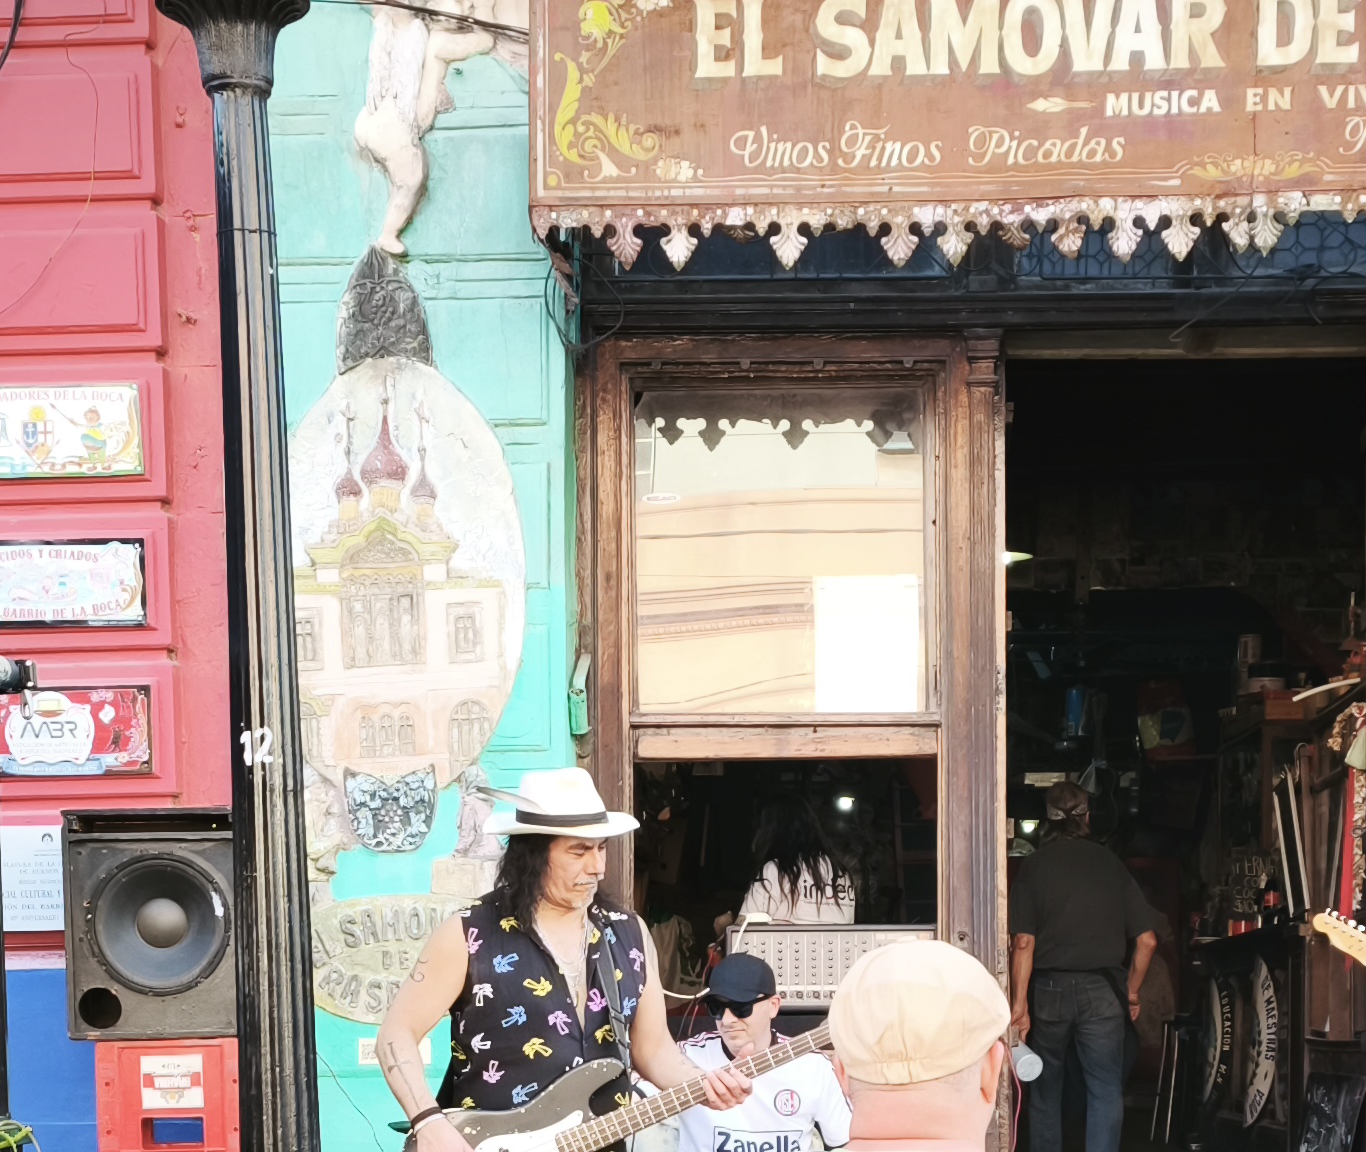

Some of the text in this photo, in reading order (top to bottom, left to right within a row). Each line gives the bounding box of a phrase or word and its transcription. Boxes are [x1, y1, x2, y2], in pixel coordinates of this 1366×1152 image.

[694, 0, 783, 78] EL
[815, 0, 1227, 78] SAMOVAR
[1257, 0, 1359, 66] DE
[1104, 89, 1222, 117] MUSICA
[1245, 87, 1292, 111] EN
[730, 123, 831, 169] Vinos
[836, 121, 943, 168] Finos
[967, 124, 1126, 166] Picadas
[53, 388, 70, 401] DE
[73, 389, 87, 401] LA
[91, 390, 125, 403] BOCA
[38, 548, 45, 560] Y
[52, 607, 67, 619] DE
[92, 599, 123, 616] BOCA
[239, 726, 274, 767] 12
[381, 949, 411, 970] DE
